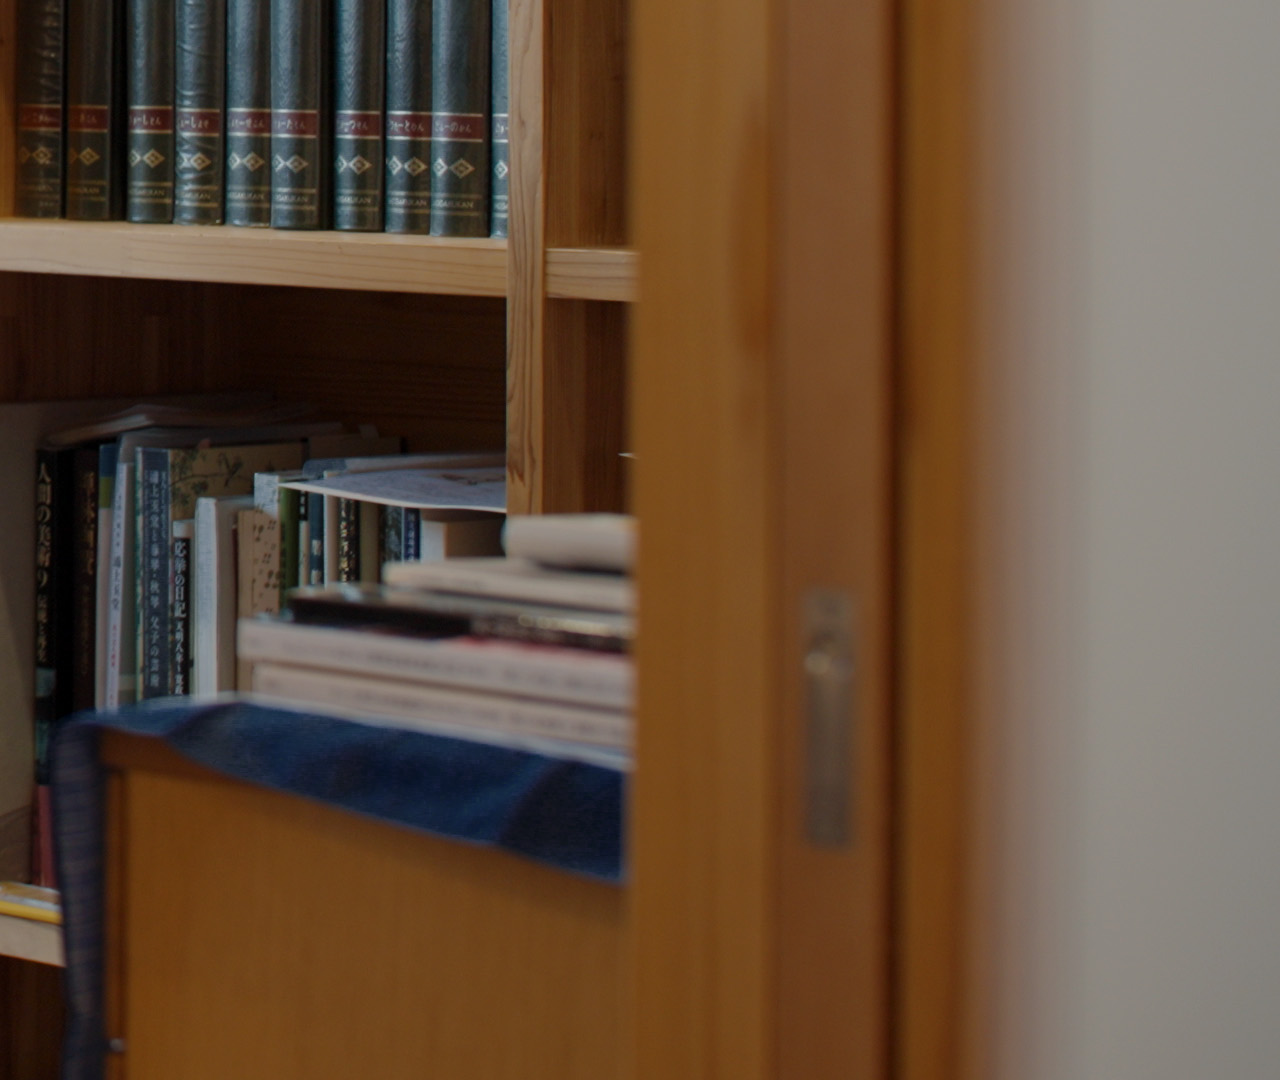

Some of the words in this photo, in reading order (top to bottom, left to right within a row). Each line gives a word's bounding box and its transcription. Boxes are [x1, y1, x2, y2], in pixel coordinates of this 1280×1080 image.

[173, 540, 187, 619] 応挙の日記
